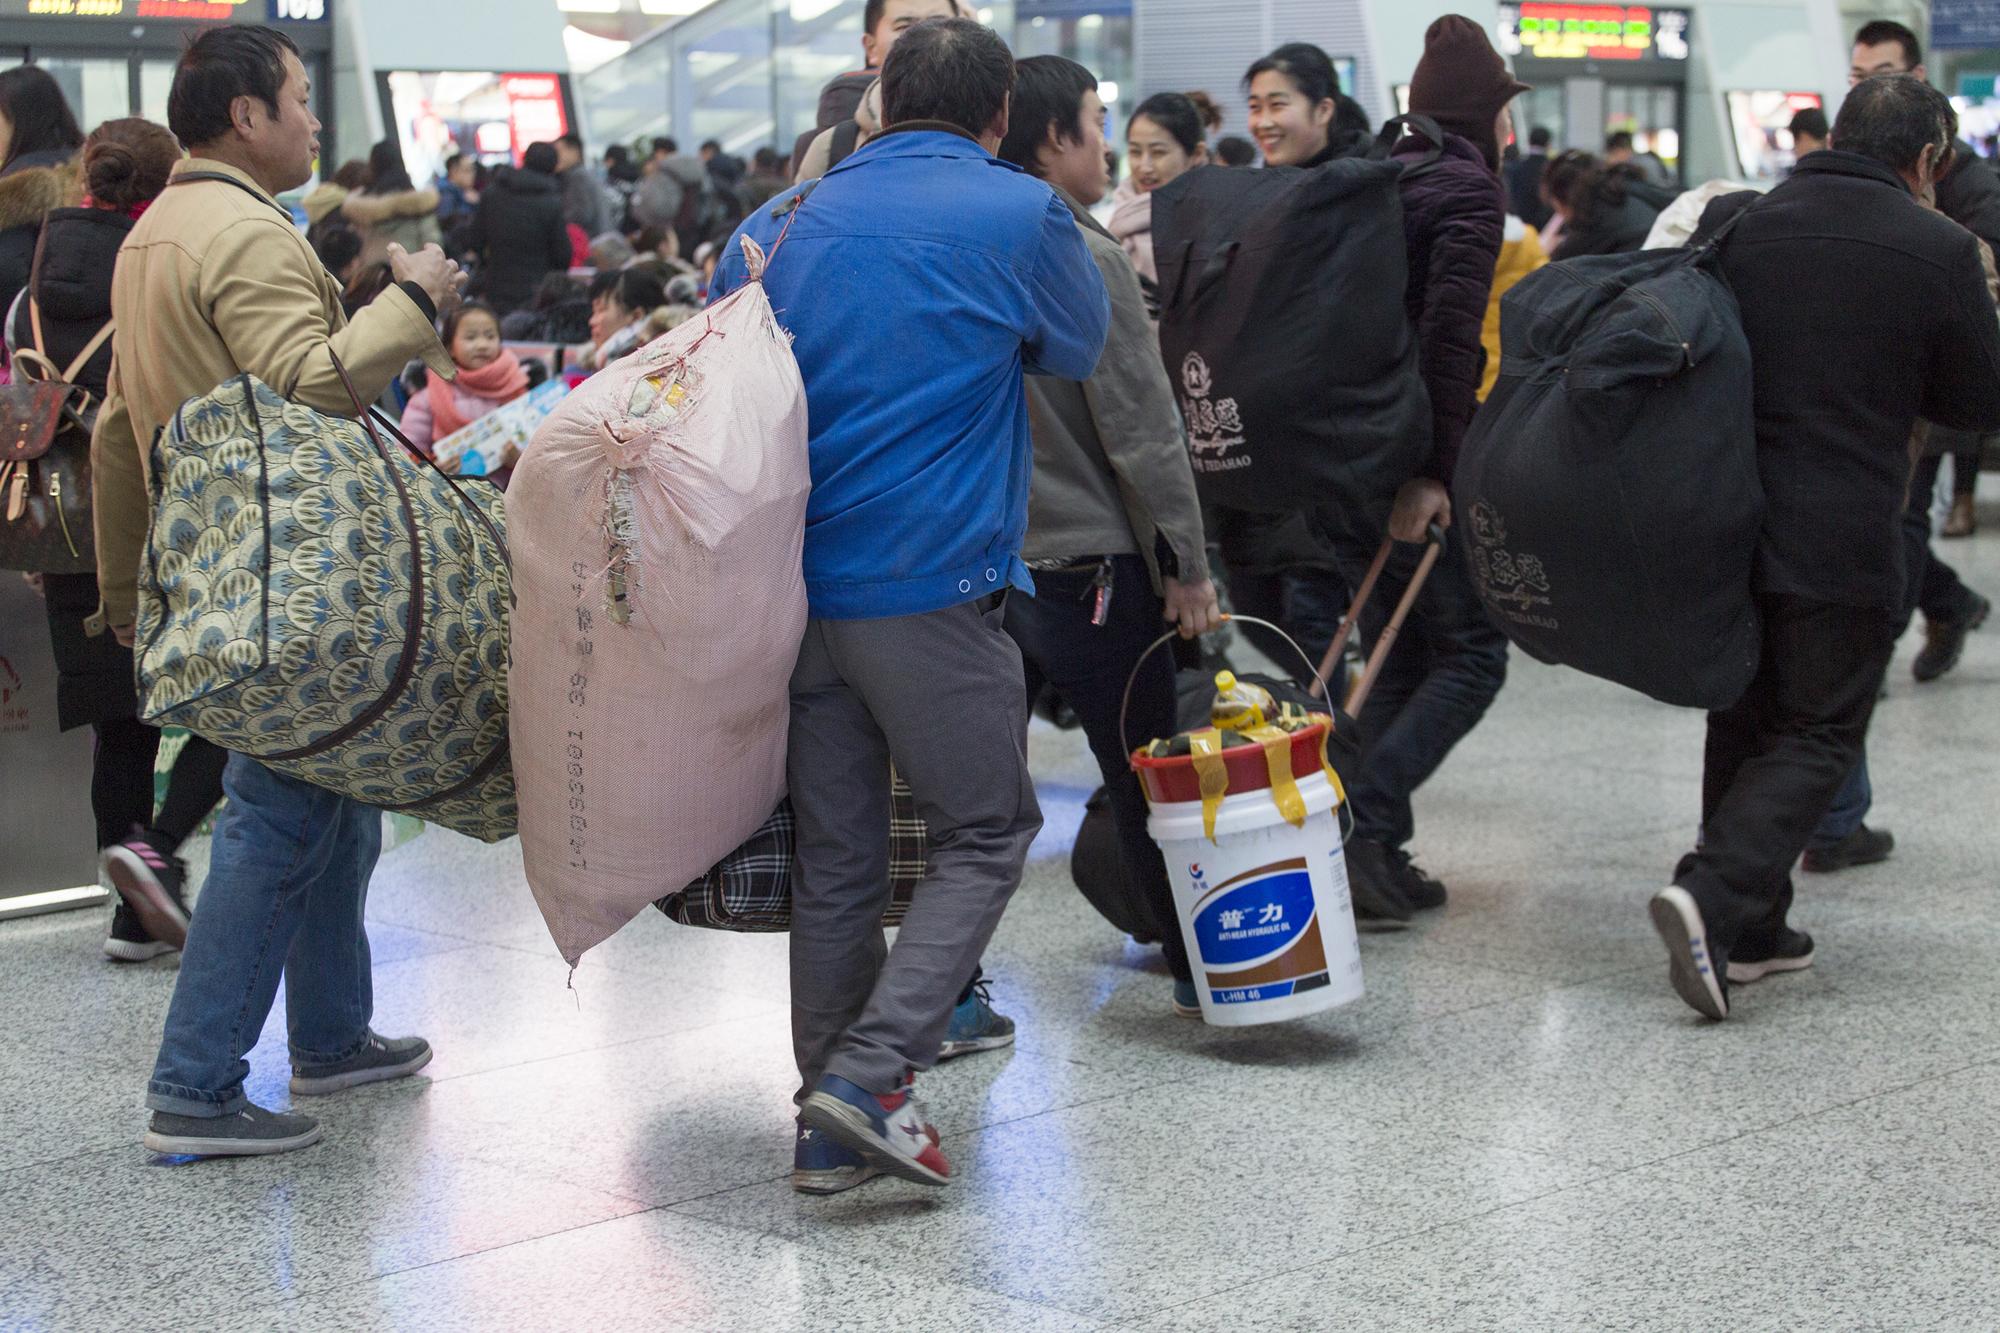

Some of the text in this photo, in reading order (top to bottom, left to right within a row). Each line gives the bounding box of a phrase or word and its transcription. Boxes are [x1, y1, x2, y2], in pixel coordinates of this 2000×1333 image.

[1218, 902, 1283, 930] 普力
[1247, 922, 1281, 938] HYDRAULIC
[1281, 922, 1291, 932] OIL
